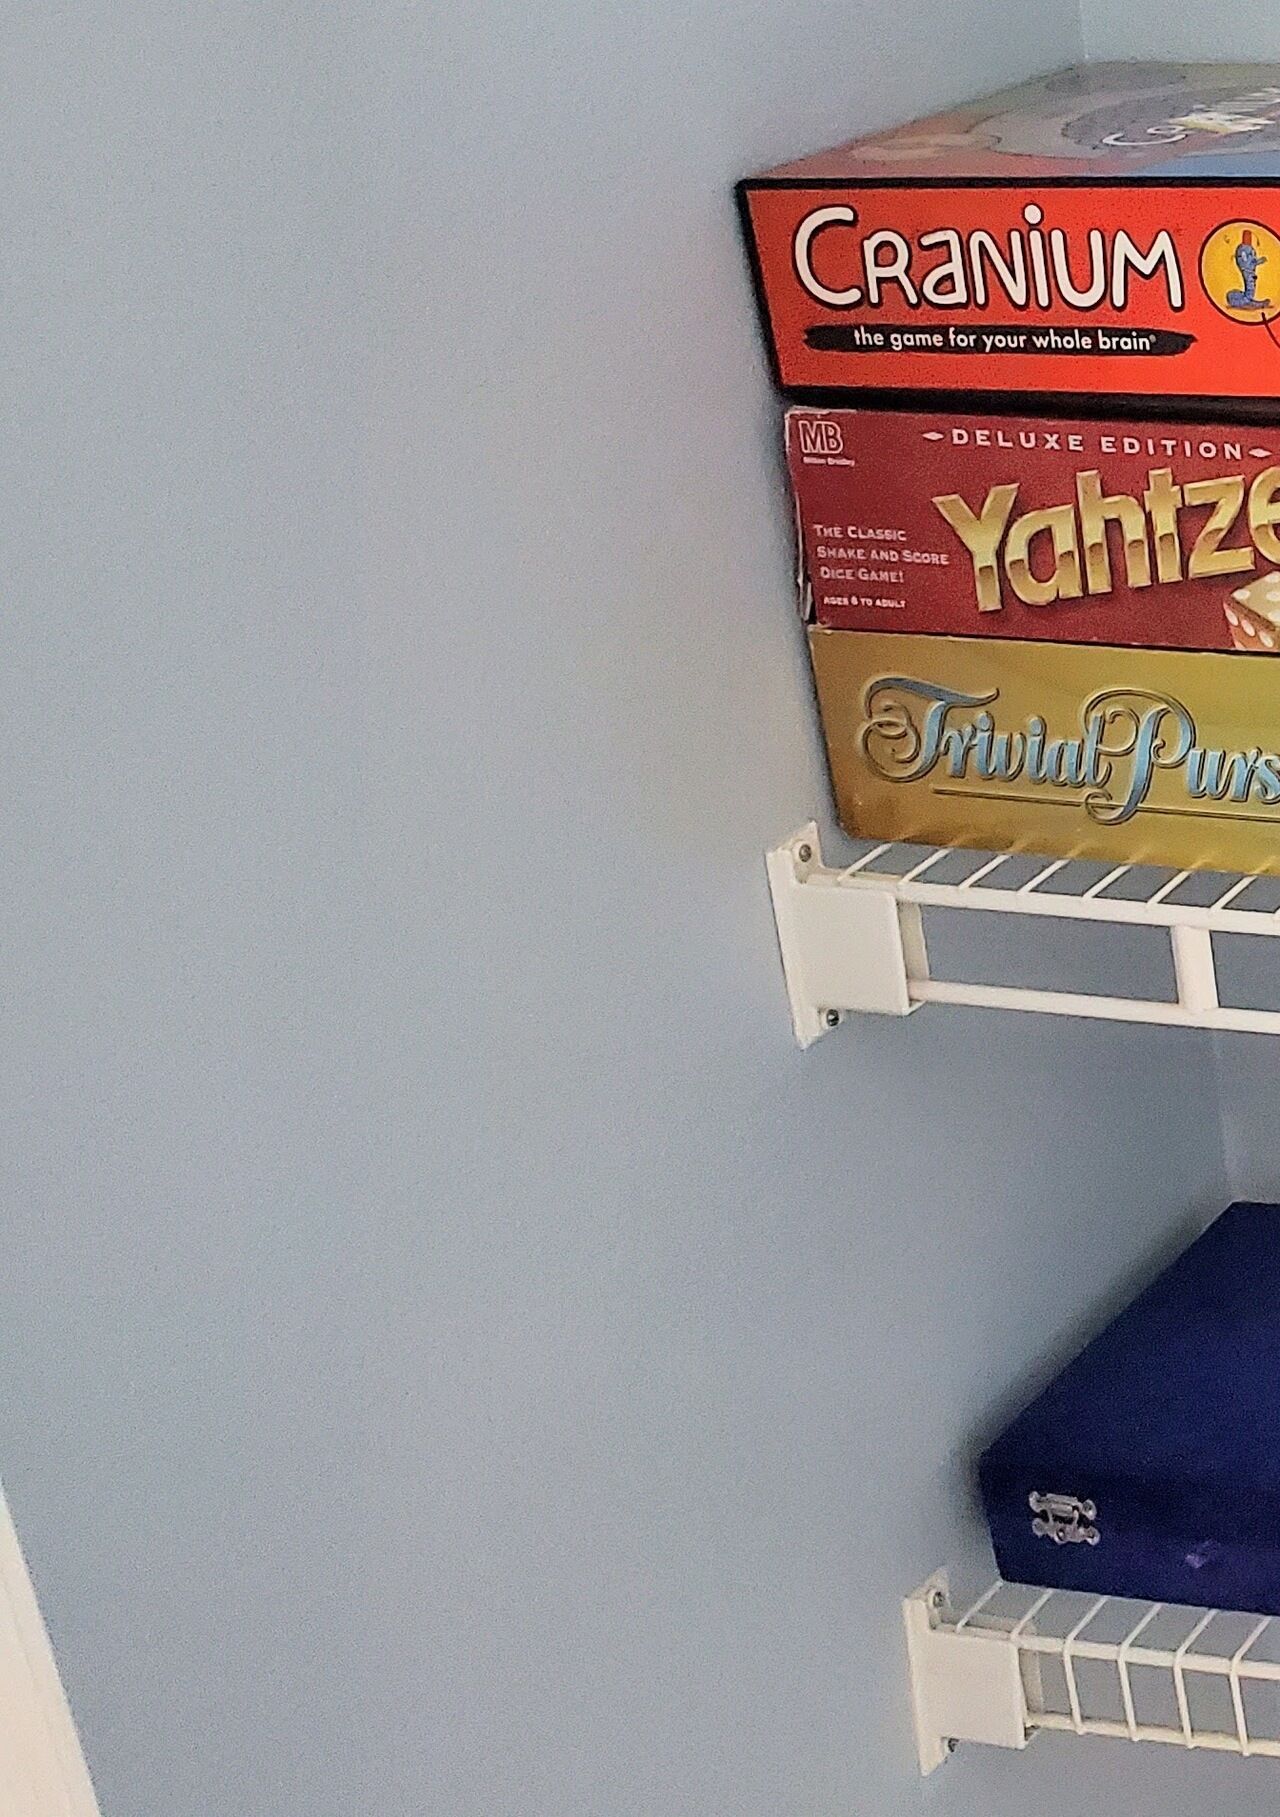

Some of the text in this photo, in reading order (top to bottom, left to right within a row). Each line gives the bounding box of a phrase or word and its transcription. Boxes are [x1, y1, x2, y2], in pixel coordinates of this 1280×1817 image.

[853, 326, 884, 346] the
[890, 331, 944, 351] game
[948, 327, 977, 347] for
[982, 333, 1027, 353] your
[1032, 329, 1092, 350] whole
[799, 420, 843, 454] MB
[952, 428, 1242, 460] DELUXE EDITION
[861, 674, 1111, 790] Trivial
